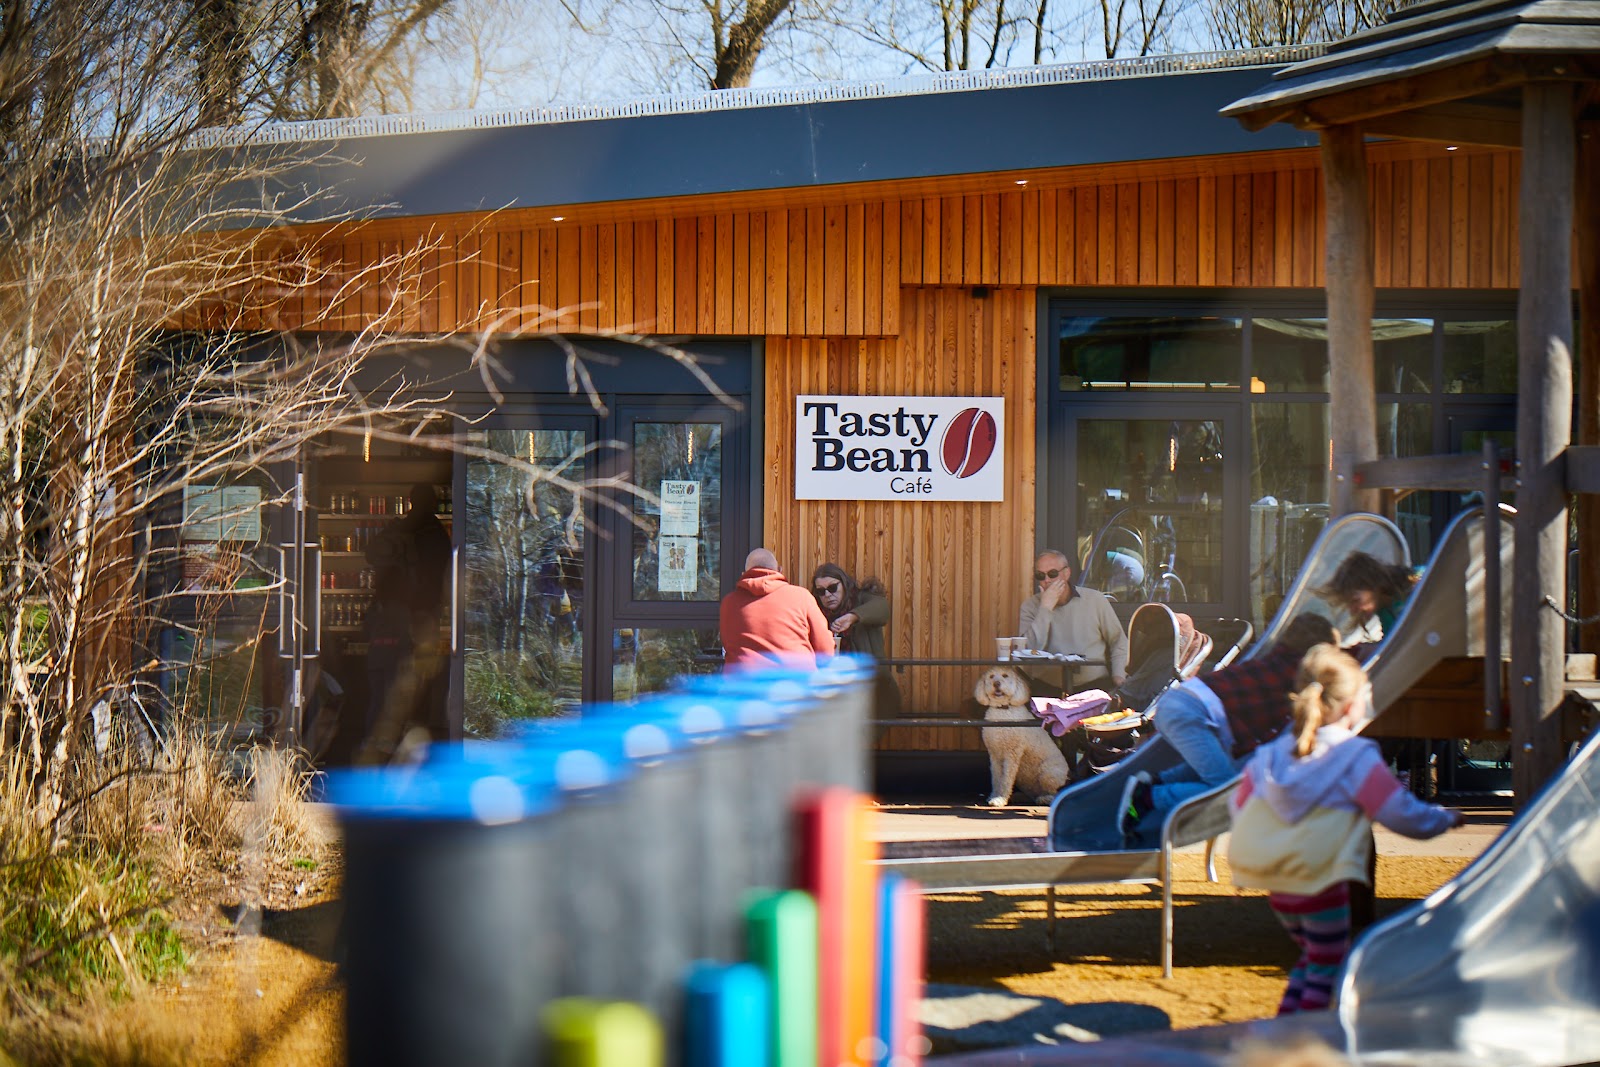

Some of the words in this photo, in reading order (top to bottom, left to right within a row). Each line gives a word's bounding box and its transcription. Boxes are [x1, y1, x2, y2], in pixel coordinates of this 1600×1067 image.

[804, 402, 938, 446] Tasty
[811, 438, 932, 472] Bean
[665, 482, 686, 490] Tasty
[890, 476, 933, 494] Café
